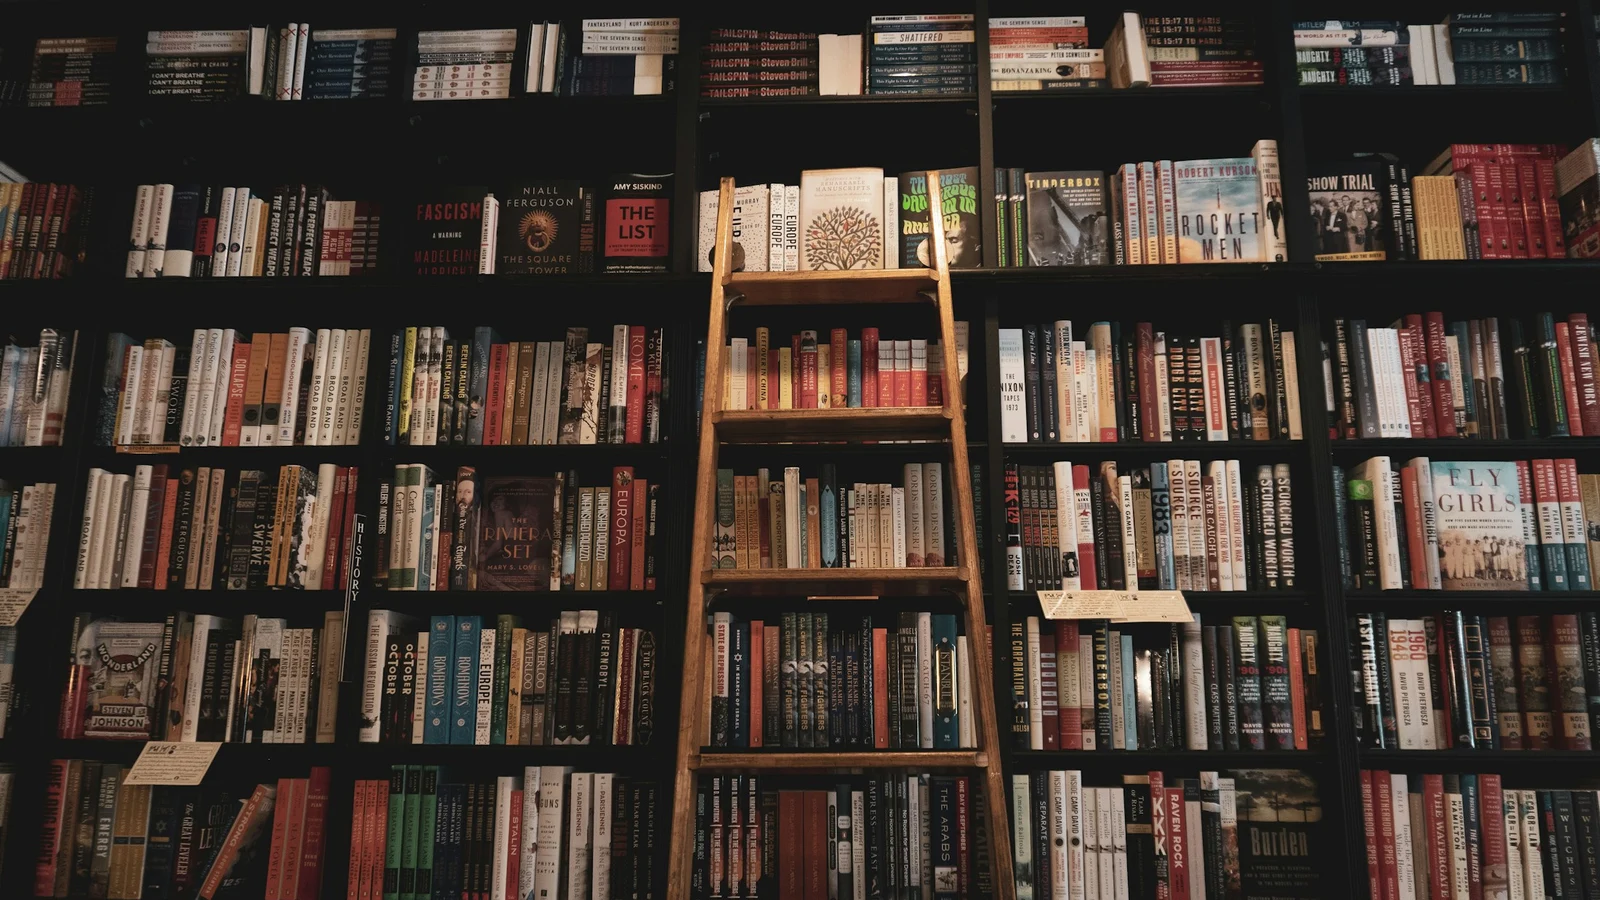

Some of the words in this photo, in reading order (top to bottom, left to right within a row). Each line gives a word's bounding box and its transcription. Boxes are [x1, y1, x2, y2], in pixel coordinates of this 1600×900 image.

[710, 43, 749, 52] TAILSPIN
[719, 29, 758, 38] TAILSPIN
[899, 33, 943, 43] SHATTERED
[1297, 51, 1329, 63] NAUGHTY
[1302, 70, 1335, 82] NAUGHTY
[1028, 178, 1100, 189] TINDERBOX
[1178, 167, 1214, 179] ROBERT
[1219, 166, 1258, 176] KURSON
[1307, 177, 1338, 190] SHOW
[1342, 174, 1375, 190] TRIAL
[417, 203, 481, 220] FASCISM
[507, 199, 574, 207] FERGUSON
[620, 206, 654, 220] THE
[620, 225, 655, 239] LIST
[771, 214, 782, 248] EUROPE
[786, 215, 796, 250] EUROPE
[1181, 212, 1259, 236] ROCKET
[527, 255, 571, 263] SQUARE
[1202, 237, 1242, 260] MEN
[1409, 324, 1420, 362] AMERICA
[1575, 325, 1590, 358] JEWISH
[630, 335, 644, 381] ROME
[1580, 361, 1592, 379] NEW
[231, 358, 247, 398] COLLAPSE
[313, 376, 321, 403] BROAD
[327, 376, 336, 403] BROAD
[443, 369, 451, 399] CALLING
[1000, 382, 1023, 392] NIXON
[1583, 383, 1596, 405] YORK
[167, 379, 180, 424] SWORD
[1172, 387, 1187, 411] CITY
[324, 405, 332, 429] BAND
[385, 404, 394, 432] RANKS
[1449, 468, 1501, 487] FLY
[181, 490, 191, 516] NIALL
[1005, 489, 1020, 524] K-129
[1153, 484, 1169, 535] 1983
[1171, 470, 1185, 520] SOURCE
[1188, 471, 1201, 520] SOURCE
[1204, 485, 1214, 515] NEVER
[1260, 479, 1276, 535] SCORCHED
[1278, 478, 1293, 535] SCORCHED
[1439, 494, 1516, 512] GIRLS
[616, 490, 628, 546] EUROPA
[1363, 510, 1372, 540] RADIUM
[1424, 501, 1437, 545] CRUCIBLE
[1541, 506, 1550, 522] WITH
[176, 520, 188, 569] FERGUSON
[251, 523, 265, 565] SWERVE
[485, 527, 552, 541] RIVIERA
[911, 514, 920, 551] DESERT
[1206, 517, 1216, 557] CAUGHT
[1545, 525, 1553, 540] FIRE
[351, 522, 364, 602] HISTORY
[503, 544, 532, 558] SET
[1264, 538, 1279, 578] WORTH
[1281, 538, 1295, 577] WORTH
[1012, 623, 1022, 636] THE
[1390, 629, 1410, 661] 1948
[1408, 630, 1427, 661] 1960
[97, 643, 156, 672] WONDERLAND
[203, 643, 218, 700] ENDURANCE
[386, 643, 399, 695] OCTOBER
[402, 644, 413, 695] OCTOBER
[523, 635, 535, 690] WATERLOO
[537, 635, 547, 689] WATERLOO
[598, 632, 610, 688] CHERNOBYL
[1012, 640, 1024, 696] CORPORATION
[1095, 628, 1109, 709] TINDERBOX
[431, 656, 447, 706] ROMANOVS
[456, 656, 471, 706] ROMANOVS
[478, 664, 491, 704] EUROPE
[940, 652, 950, 699] ISTANBUL
[93, 717, 143, 727] JOHNSON
[1402, 694, 1412, 726] PIETRUSZA
[540, 799, 559, 808] GUNS
[869, 780, 877, 825] EMPRESS
[1171, 794, 1181, 832] RAVEN
[1362, 784, 1374, 836] BROTHERHOOD
[1434, 793, 1443, 817] THE
[96, 818, 111, 857] ENERGY
[941, 816, 950, 861] ARABS
[1152, 797, 1167, 856] KKK
[1451, 800, 1460, 850] HAMILTON
[1173, 836, 1183, 867] ROCK
[1251, 827, 1308, 856] Burden
[1367, 845, 1376, 864] SPIES
[1560, 816, 1577, 886] WITCHES
[1436, 821, 1449, 897] WATERGATE
